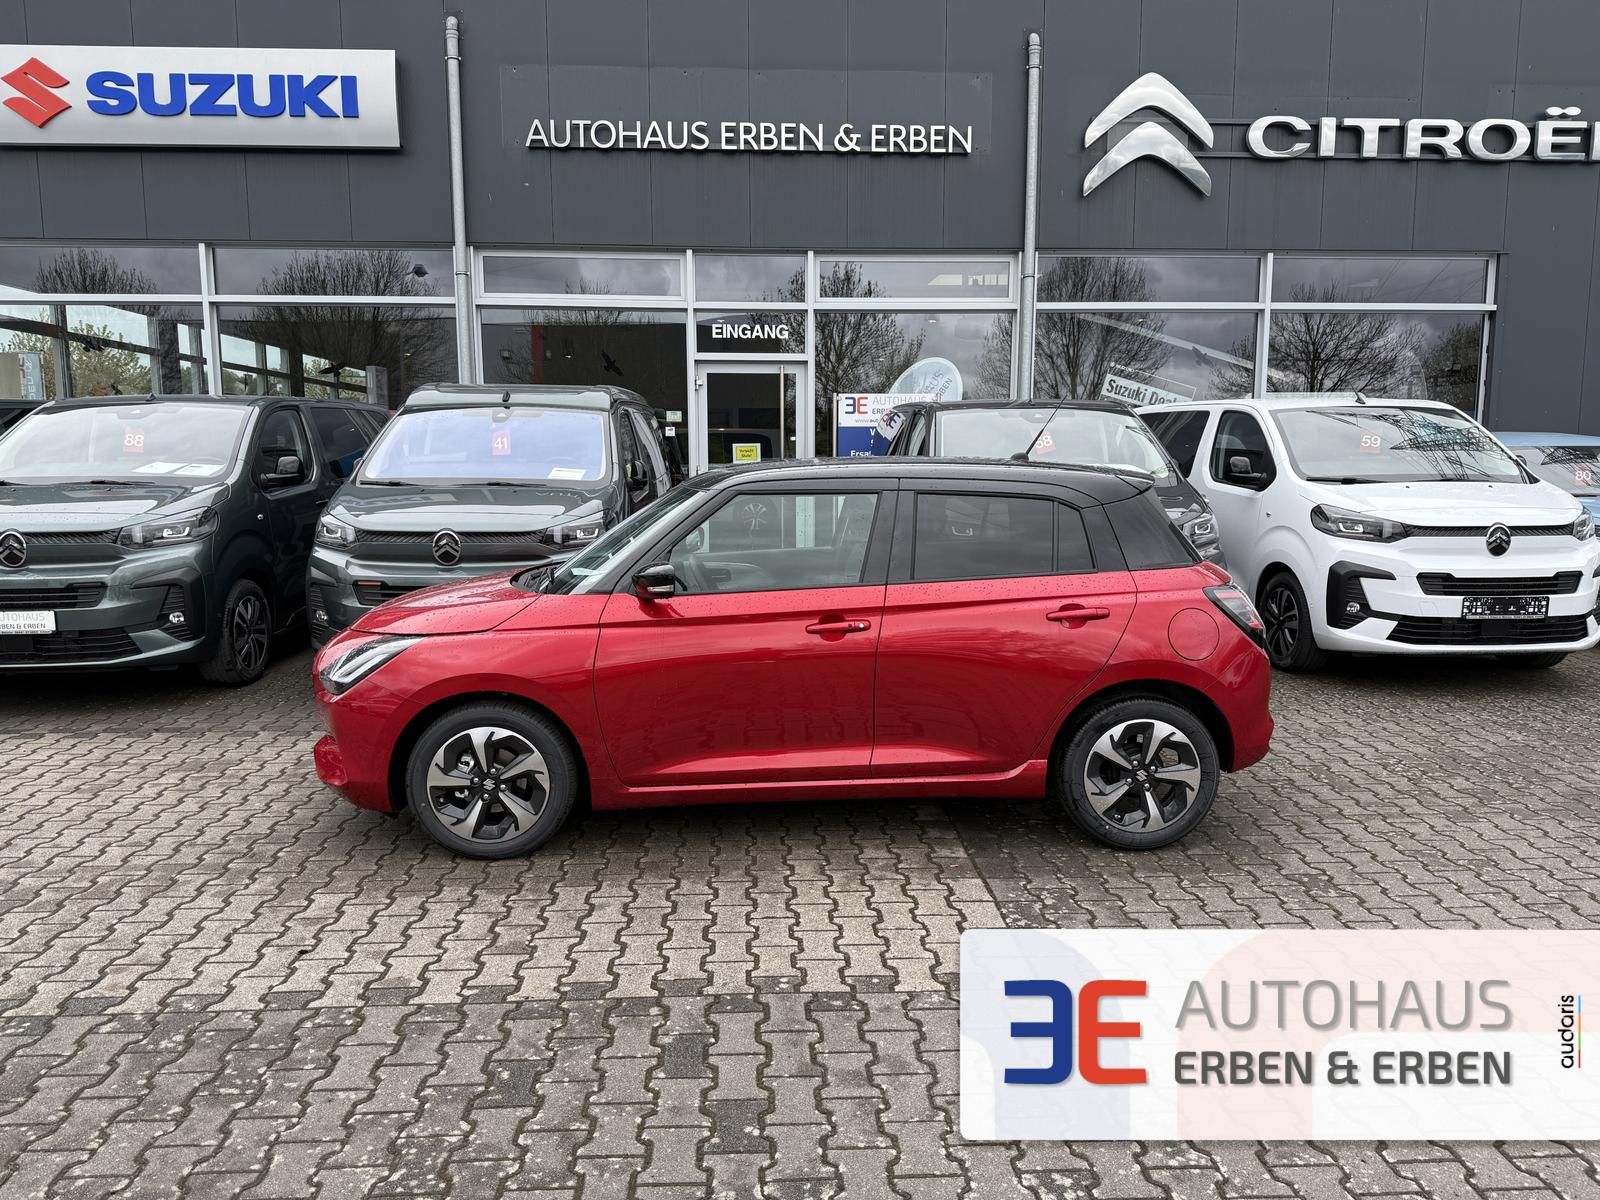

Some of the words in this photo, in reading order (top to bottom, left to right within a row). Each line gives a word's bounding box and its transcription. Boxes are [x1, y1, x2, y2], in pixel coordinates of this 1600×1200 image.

[86, 71, 359, 118] SUZUKI
[525, 119, 709, 150] AUTOHAUS
[721, 122, 824, 151] ERBEN
[834, 123, 861, 152] &
[872, 125, 973, 153] ERBEN
[1247, 106, 1600, 160] CITROË
[712, 324, 789, 339] EINGANG
[1106, 379, 1148, 403] Suzuki
[124, 433, 144, 447] 88
[494, 437, 508, 449] 41
[1361, 435, 1381, 448] 59
[1575, 470, 1591, 480] 80
